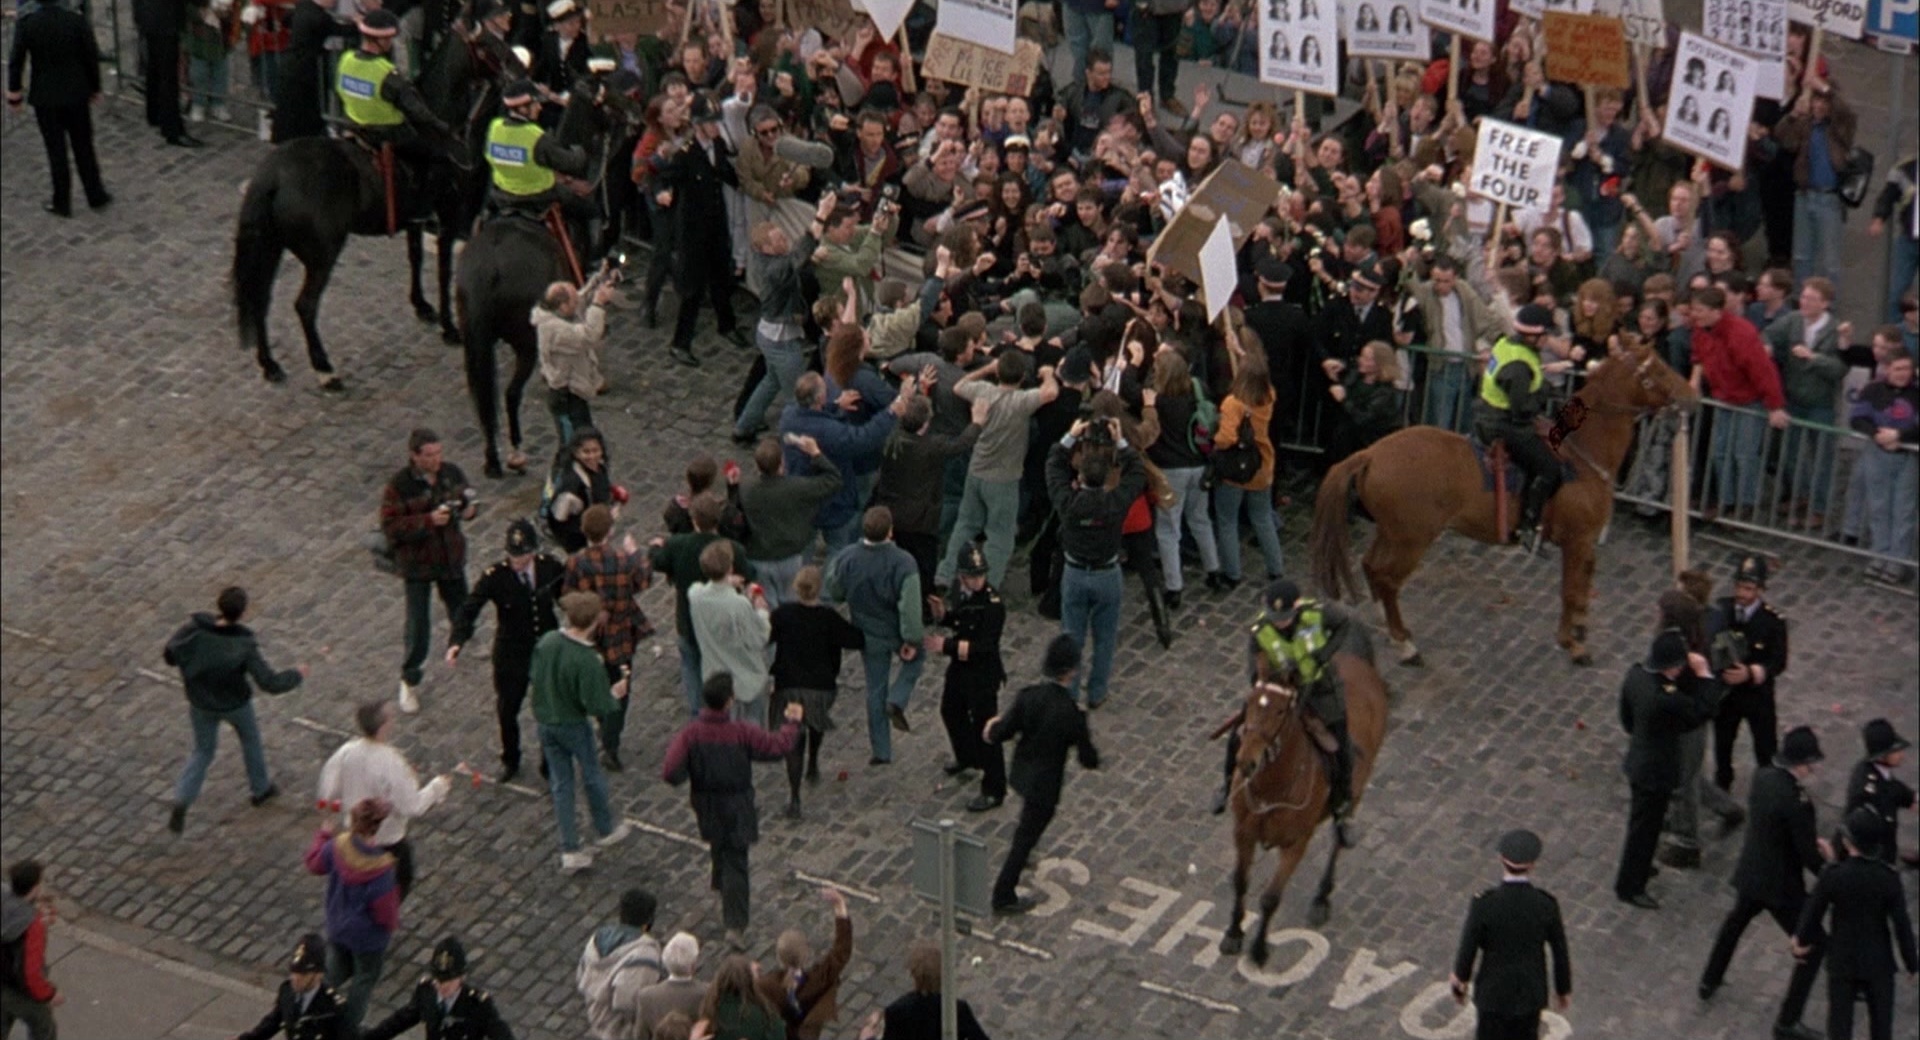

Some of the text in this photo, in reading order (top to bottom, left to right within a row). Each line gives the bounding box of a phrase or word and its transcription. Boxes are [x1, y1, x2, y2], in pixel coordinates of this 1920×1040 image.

[1881, 0, 1918, 29] P
[493, 146, 523, 160] POLICE
[1489, 128, 1539, 158] FREE
[1493, 153, 1529, 180] THE
[1481, 174, 1539, 206] FOUR
[1014, 857, 1573, 1040] OACHES
